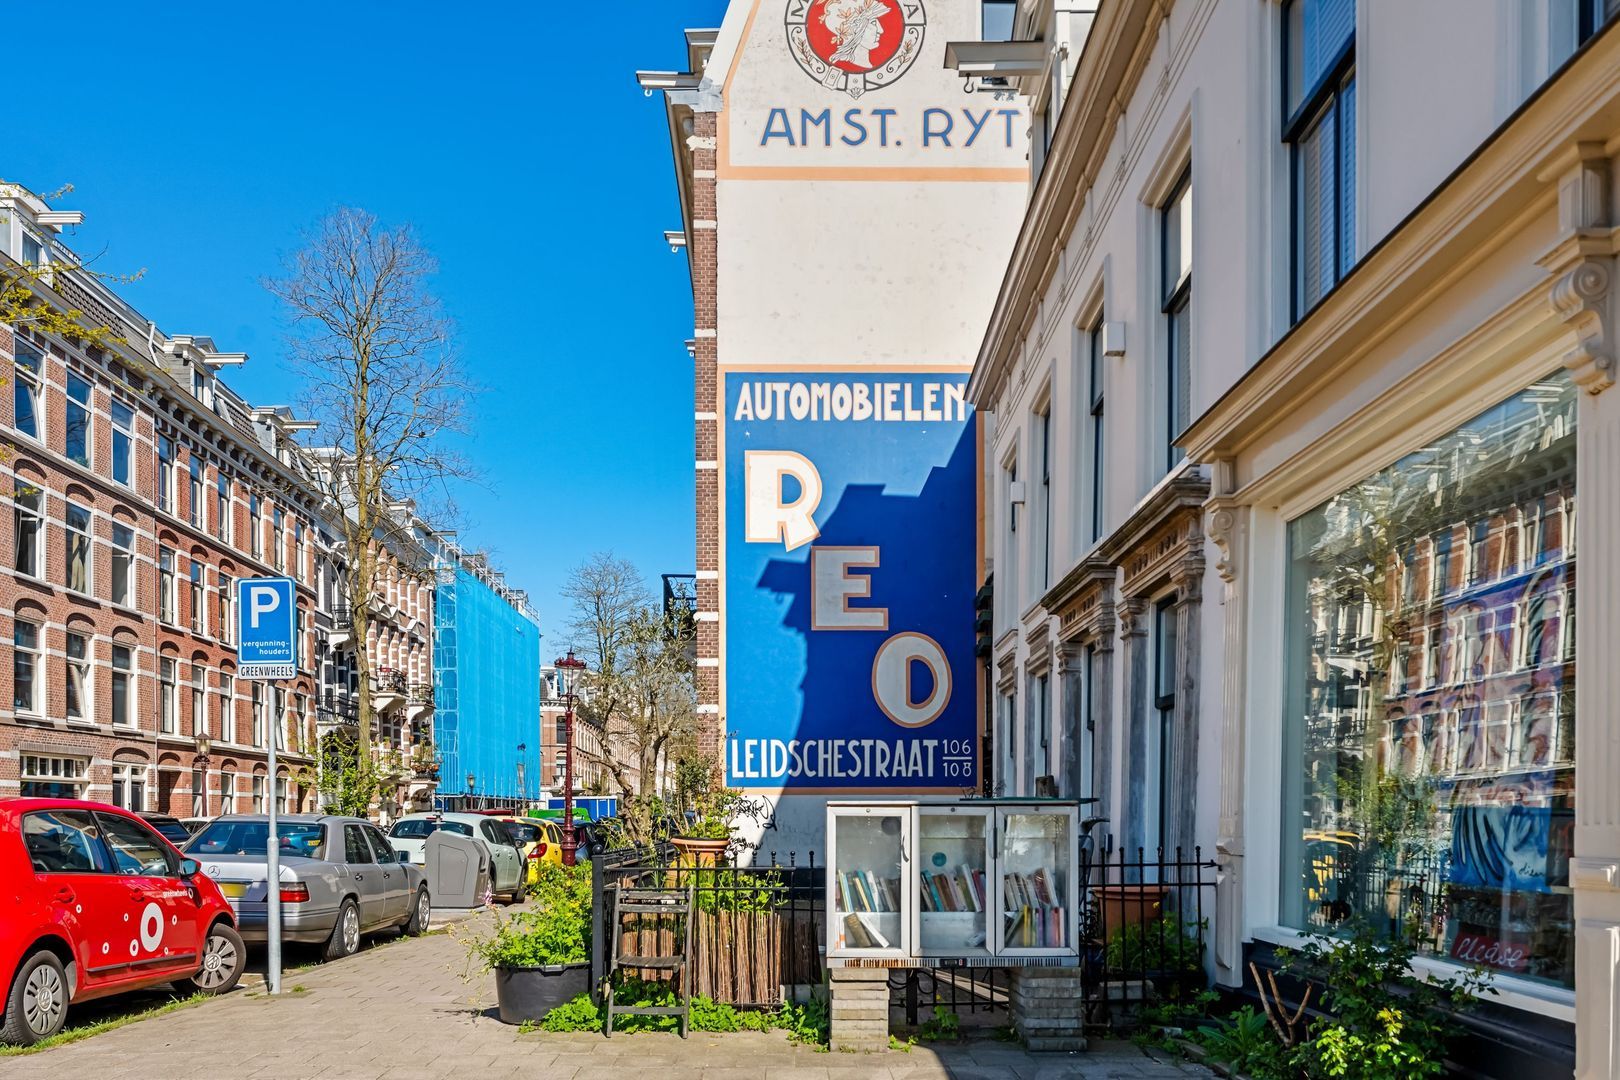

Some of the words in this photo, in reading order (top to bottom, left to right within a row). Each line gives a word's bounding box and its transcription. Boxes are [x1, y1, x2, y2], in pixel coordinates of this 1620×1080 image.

[759, 108, 902, 147] AMST.
[922, 108, 1022, 147] RYT
[734, 382, 966, 422] AUTOMOBIELEN
[250, 586, 281, 629] P
[243, 640, 290, 649] vergunning-
[241, 666, 293, 677] GREENWHEELS
[731, 739, 938, 779] LEIDSCHESTRAAT
[943, 738, 971, 754] 106
[943, 762, 971, 777] 108
